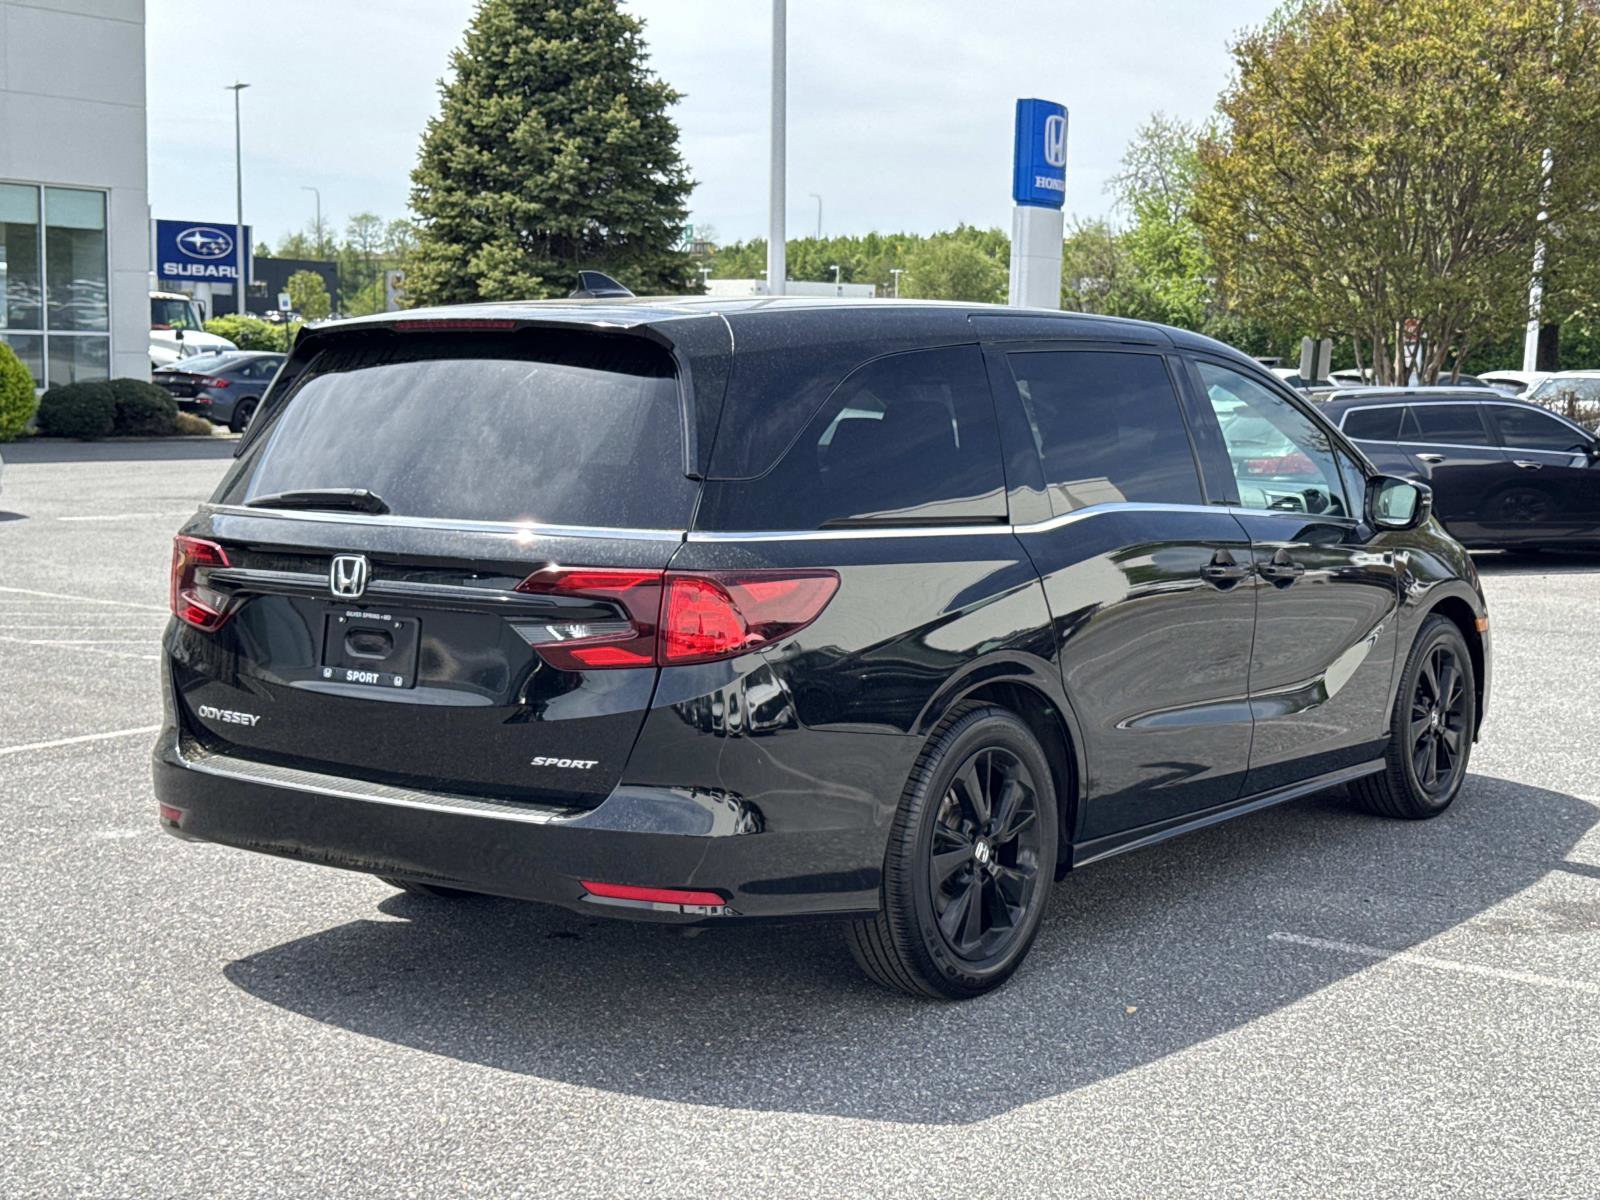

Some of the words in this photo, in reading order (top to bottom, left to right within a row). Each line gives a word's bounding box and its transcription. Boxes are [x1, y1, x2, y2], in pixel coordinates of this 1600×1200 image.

[346, 670, 379, 684] SPORT
[199, 705, 261, 727] ODYSSEY
[530, 756, 599, 769] SPORT
